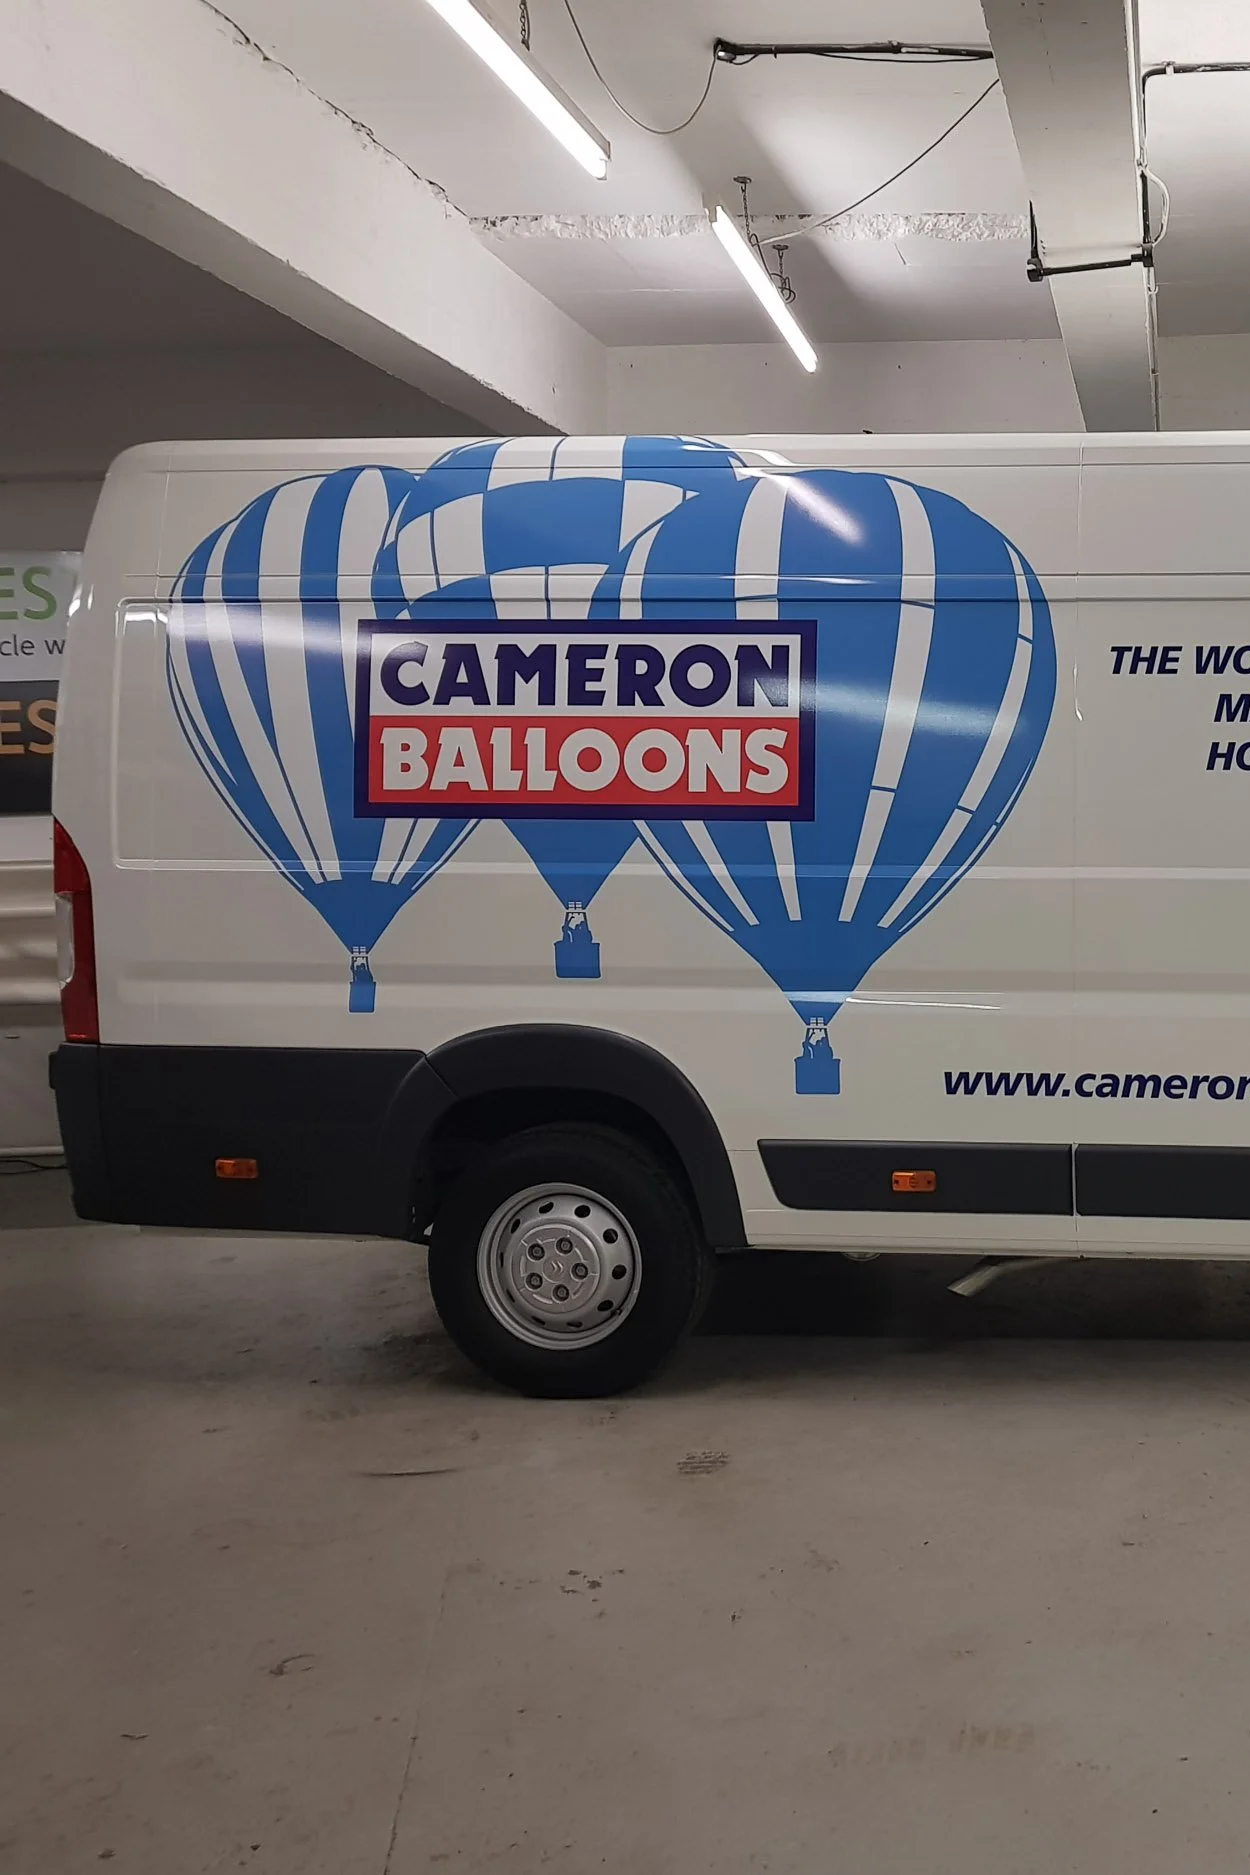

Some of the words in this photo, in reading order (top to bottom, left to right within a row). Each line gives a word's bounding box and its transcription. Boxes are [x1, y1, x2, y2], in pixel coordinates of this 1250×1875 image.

[380, 640, 790, 707] CAMERON
[1110, 645, 1183, 675] THE
[380, 727, 790, 795] BALLOONS
